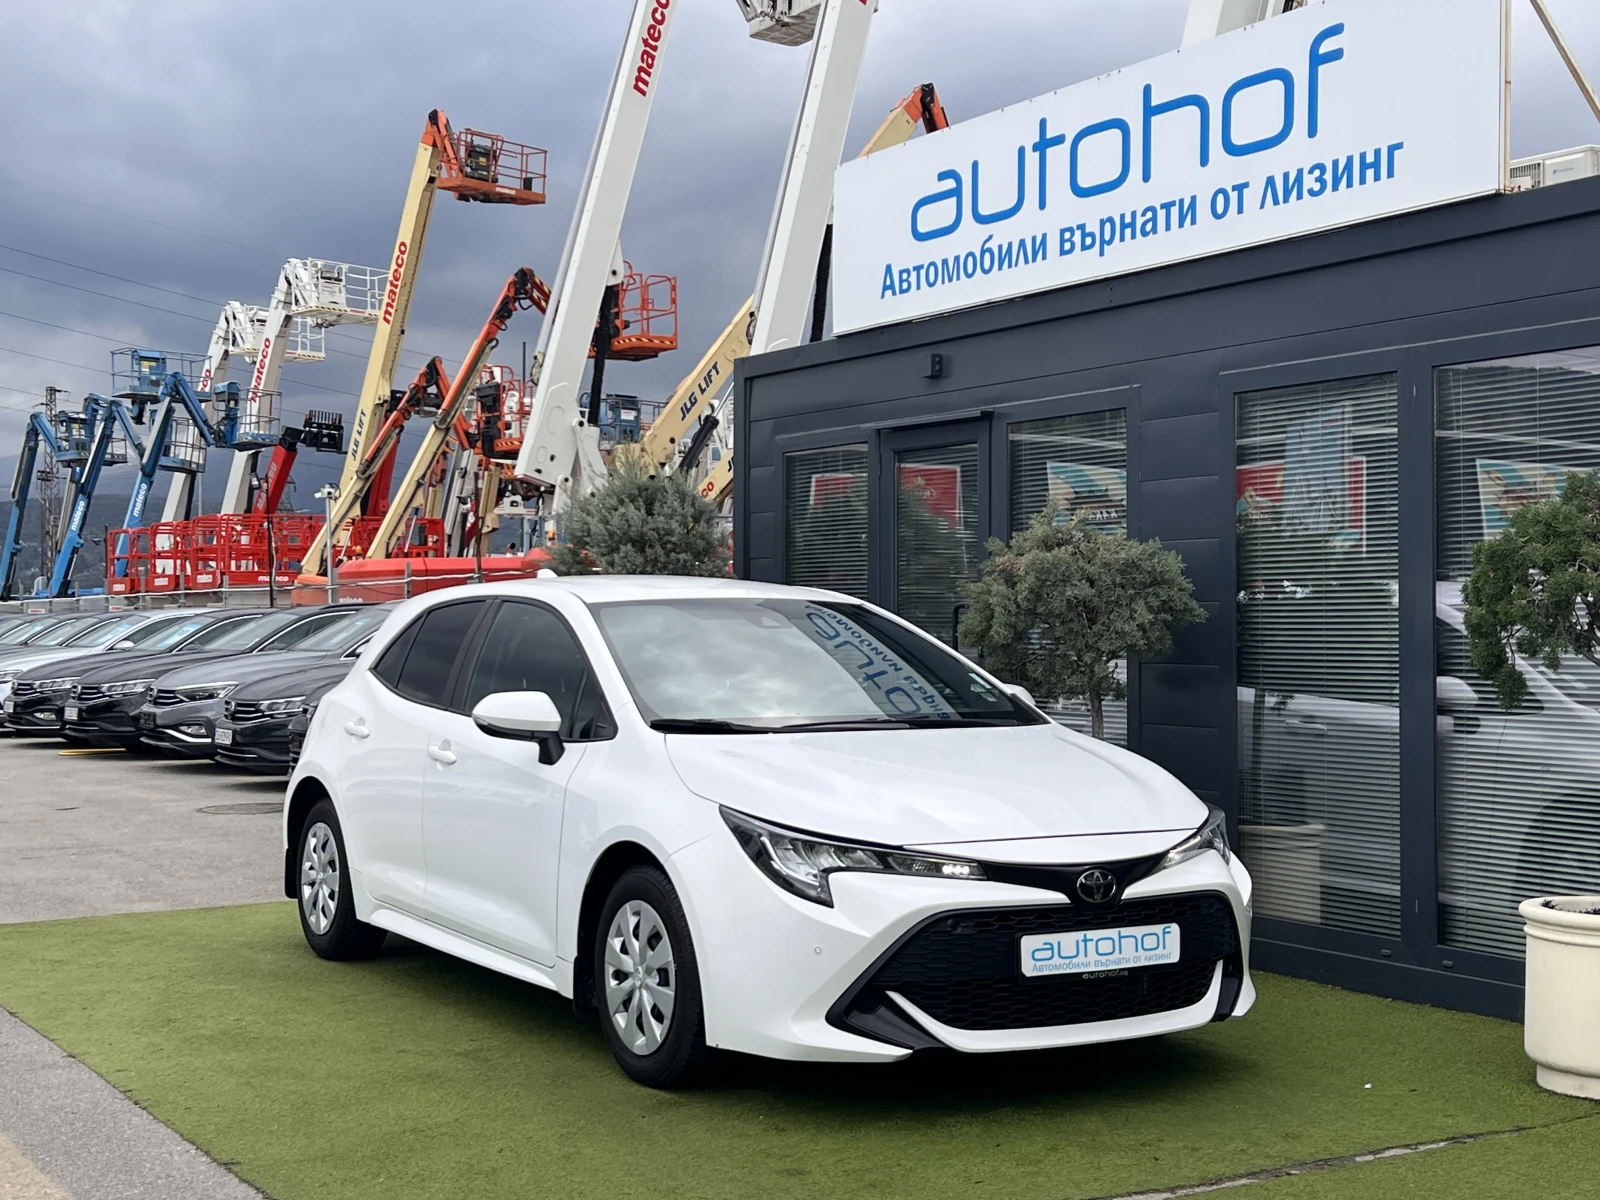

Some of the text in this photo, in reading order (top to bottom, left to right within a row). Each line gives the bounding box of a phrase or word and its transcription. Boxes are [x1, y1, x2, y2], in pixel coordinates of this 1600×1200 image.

[911, 22, 1345, 243] autohof
[880, 142, 1405, 299] Автомобили върнати от лизинг
[383, 241, 407, 325] mateco
[251, 337, 271, 403] mateco
[680, 361, 720, 422] JLG LIFT
[351, 408, 366, 461] JLG LIFT
[71, 500, 85, 531] mateco
[133, 483, 147, 517] mateco
[1031, 925, 1172, 962] autohof
[1032, 952, 1172, 973] Автомобили върнати от лизинг
